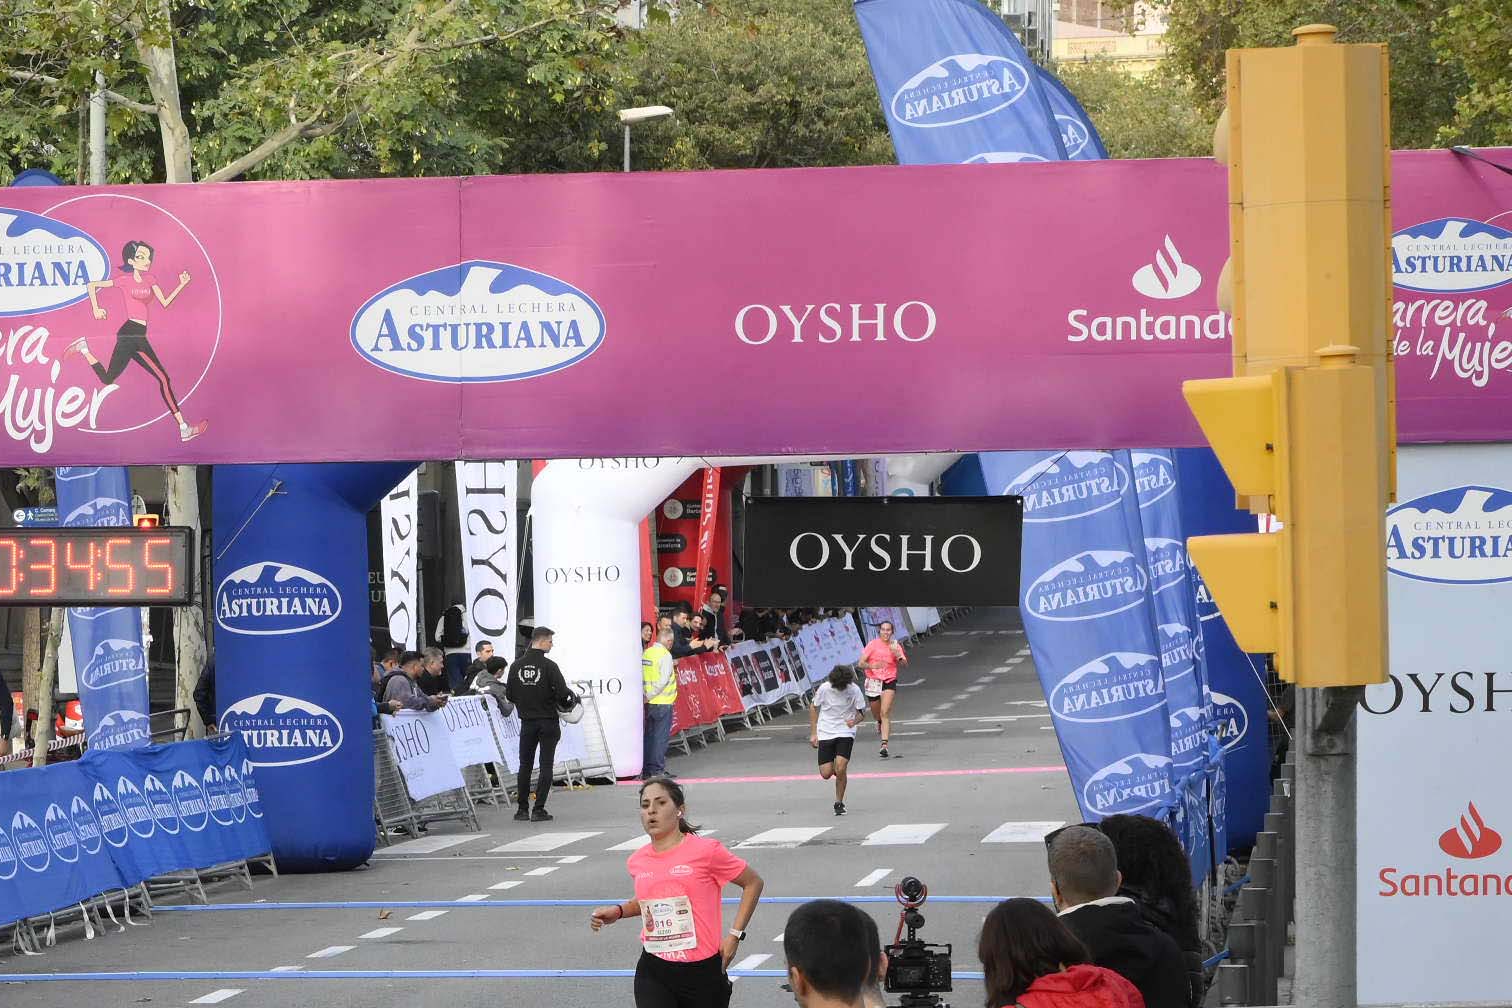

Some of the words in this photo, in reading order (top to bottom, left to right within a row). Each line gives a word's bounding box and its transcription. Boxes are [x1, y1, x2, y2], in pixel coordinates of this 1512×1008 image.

[13, 243, 85, 256] LECHERA
[1407, 243, 1458, 252] CENTRAL
[409, 303, 488, 318] CENTRAL
[496, 301, 577, 315] LECHERA
[1393, 299, 1488, 327] arrera
[370, 308, 586, 353] ASTURIANA
[734, 301, 937, 345] OYSHO
[1067, 308, 1233, 344] Santand
[1416, 328, 1434, 356] la
[1429, 322, 1512, 388] Muje
[1413, 520, 1480, 531] CENTRAL
[789, 532, 982, 573] OYSHO
[1386, 523, 1512, 560] ASTURI
[545, 565, 621, 585] OYSHO
[232, 585, 276, 596] CENTRAL
[278, 585, 328, 595] LECHERA
[219, 593, 332, 618] ASTURIANA
[524, 670, 536, 678] BP
[576, 678, 622, 696] SHO
[1360, 671, 1512, 714] OYSH
[233, 718, 276, 728] CENTRAL
[279, 717, 329, 726] LECHERA
[1378, 867, 1512, 897] Santan
